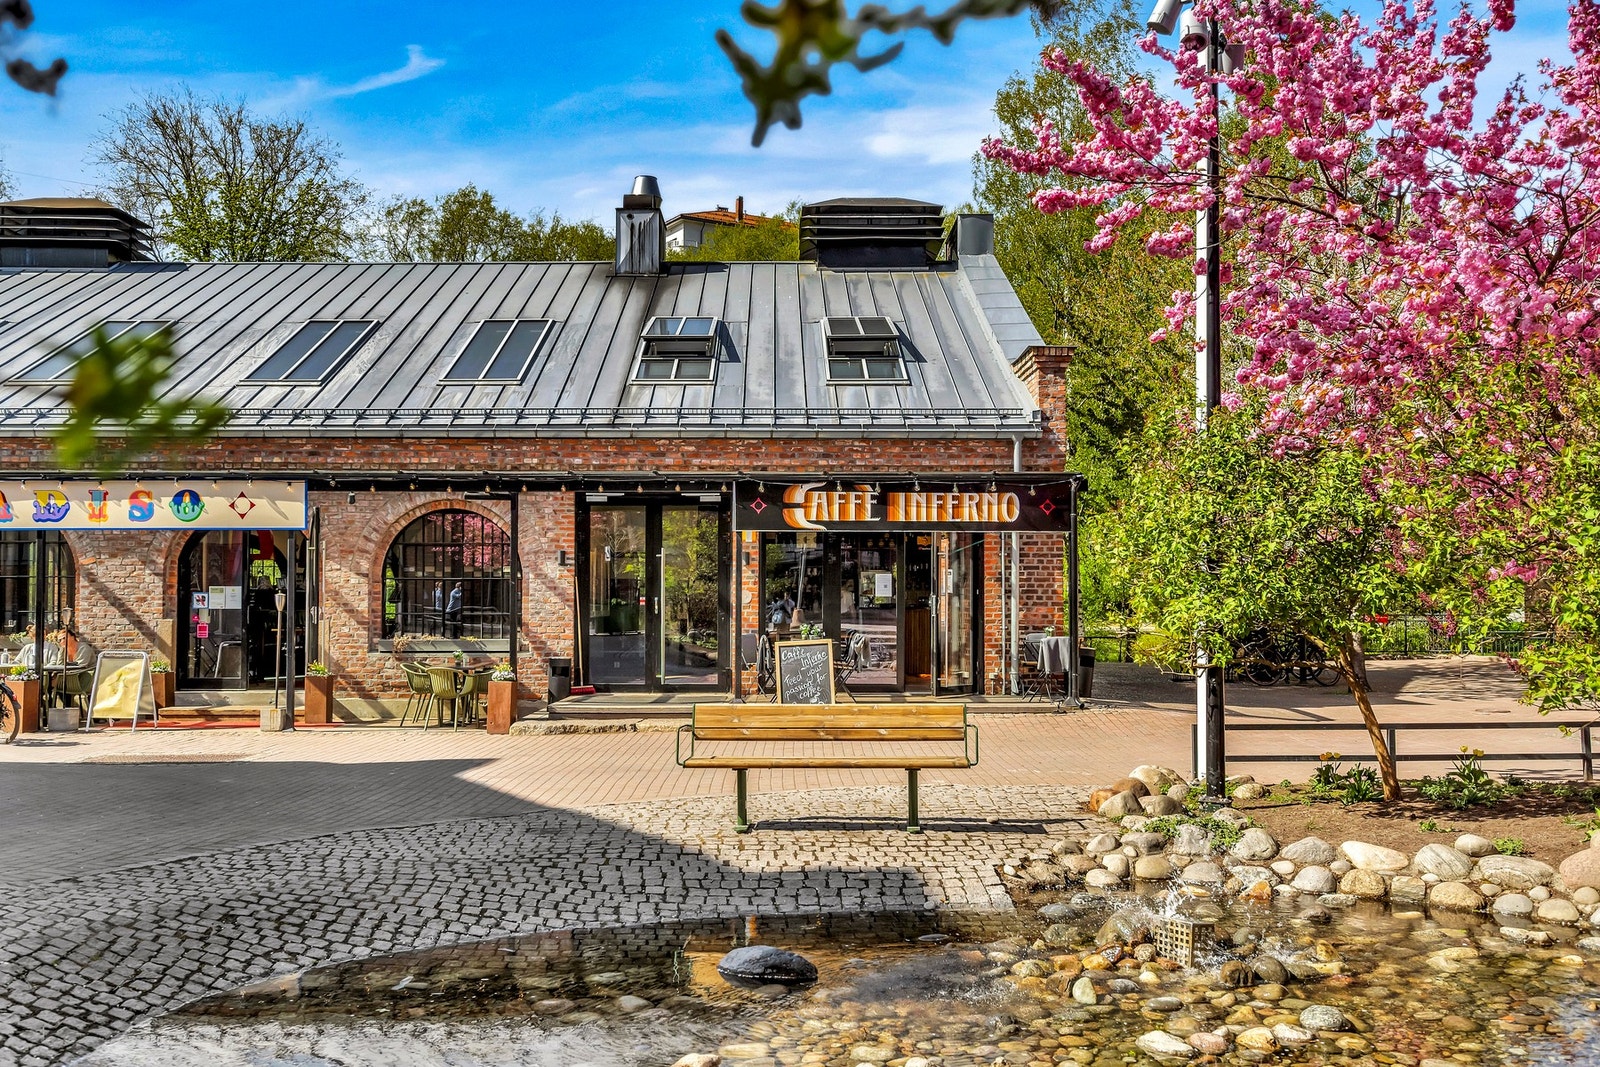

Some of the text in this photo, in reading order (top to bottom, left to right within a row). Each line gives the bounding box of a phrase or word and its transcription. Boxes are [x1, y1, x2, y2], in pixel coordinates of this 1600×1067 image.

[887, 491, 1020, 523] INFERNO
[801, 651, 827, 668] Inferno
[807, 663, 823, 682] your
[785, 681, 812, 701] passion
[800, 686, 822, 699] coffee
